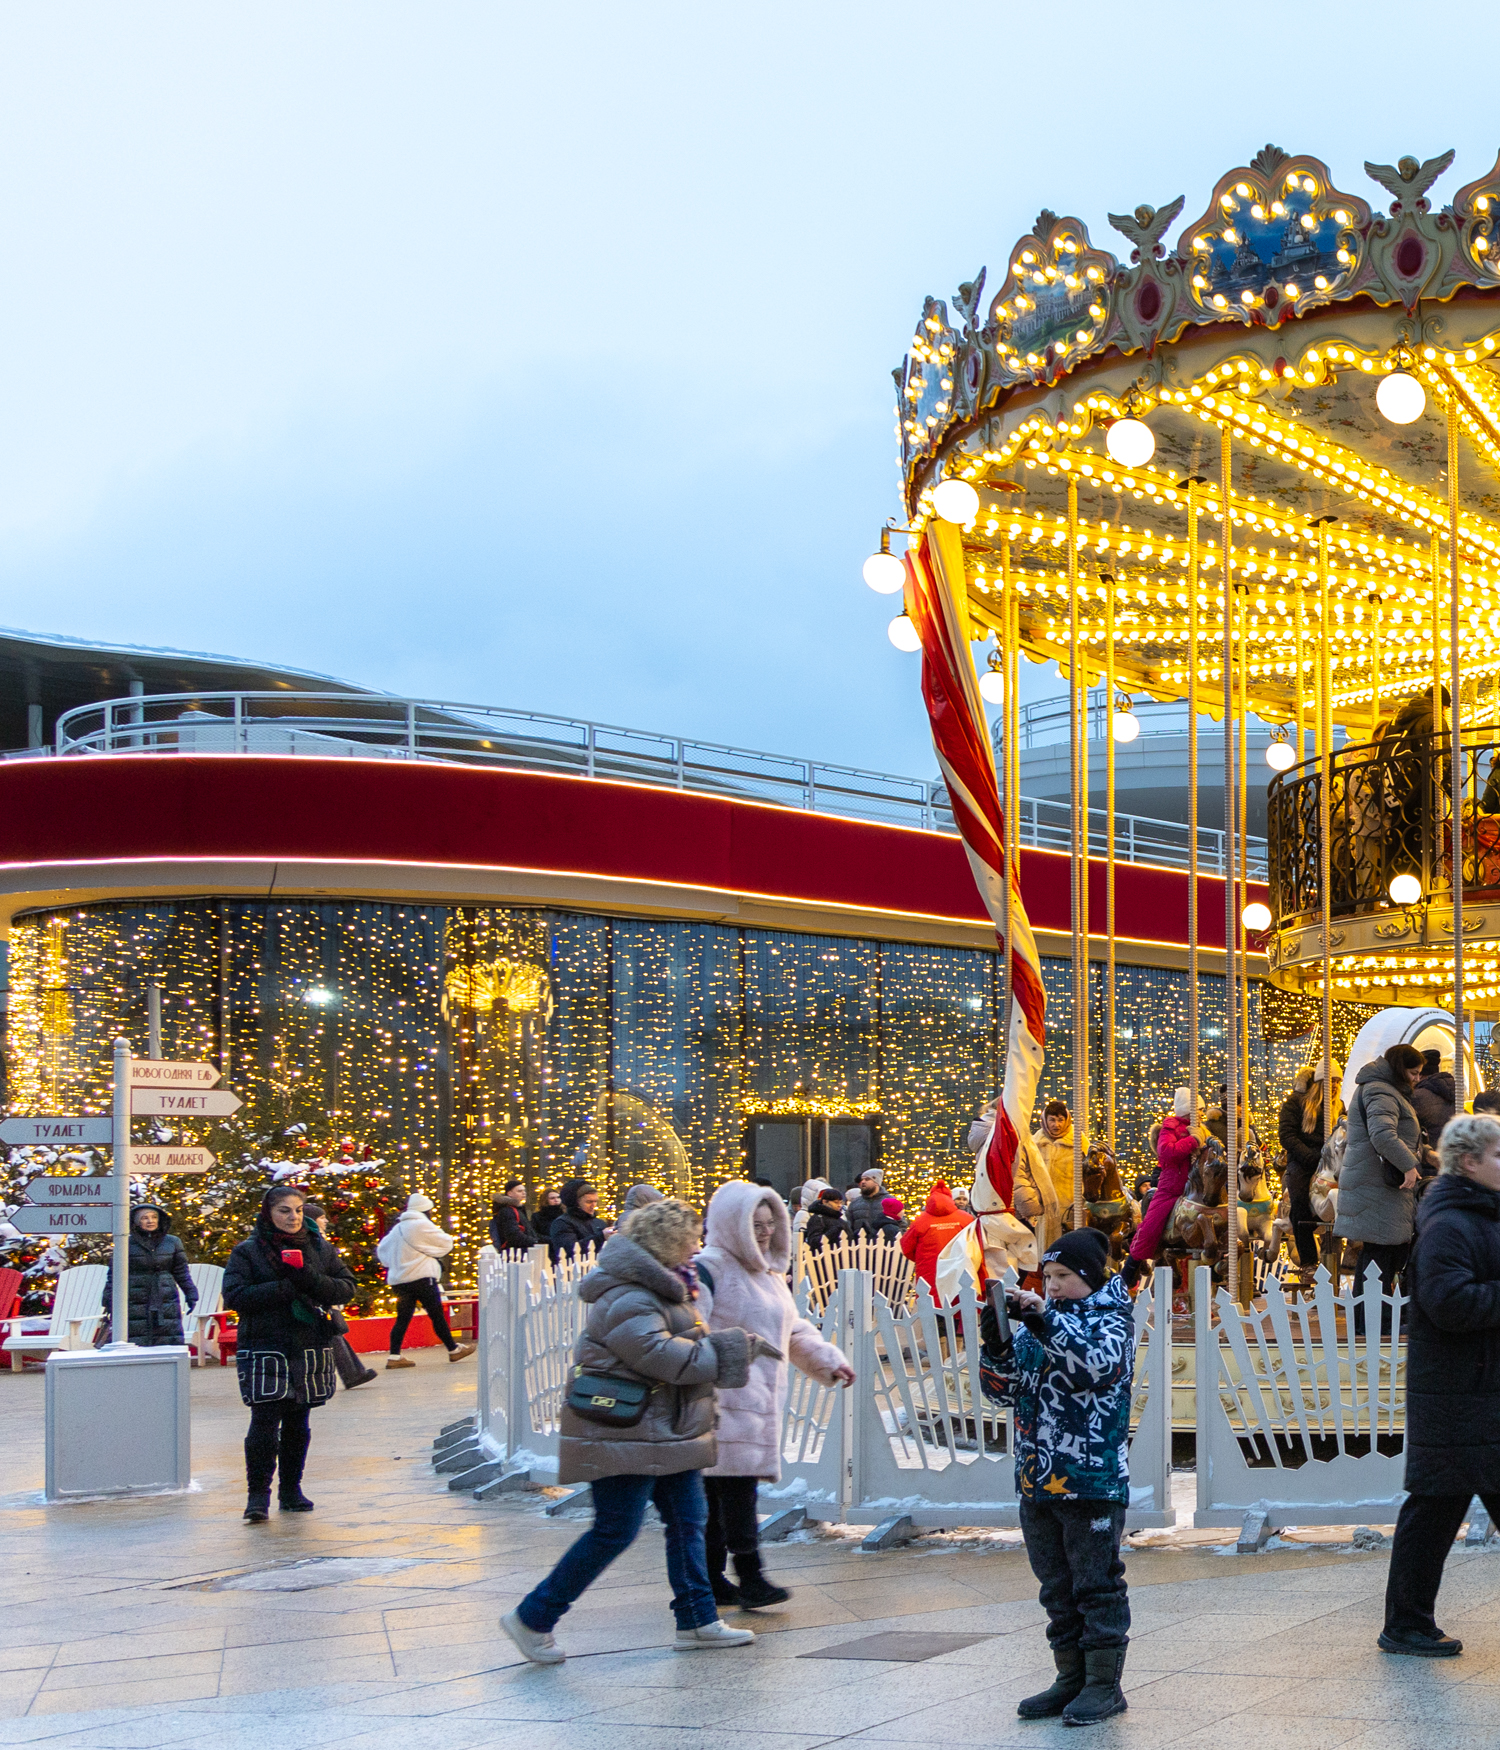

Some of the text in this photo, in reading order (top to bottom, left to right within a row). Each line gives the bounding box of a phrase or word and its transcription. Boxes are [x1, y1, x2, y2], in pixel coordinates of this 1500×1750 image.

[132, 1067, 213, 1081] НОВОГОДНЯЯ ЕЛЬ
[158, 1095, 208, 1109] ТУАЛЕТ
[33, 1124, 85, 1137] ТУАЛЕТ
[133, 1153, 204, 1166] ЗОНА ДИДЖЕЯ
[48, 1184, 101, 1197] ЯРМАРКА
[49, 1213, 87, 1226] КАТОК
